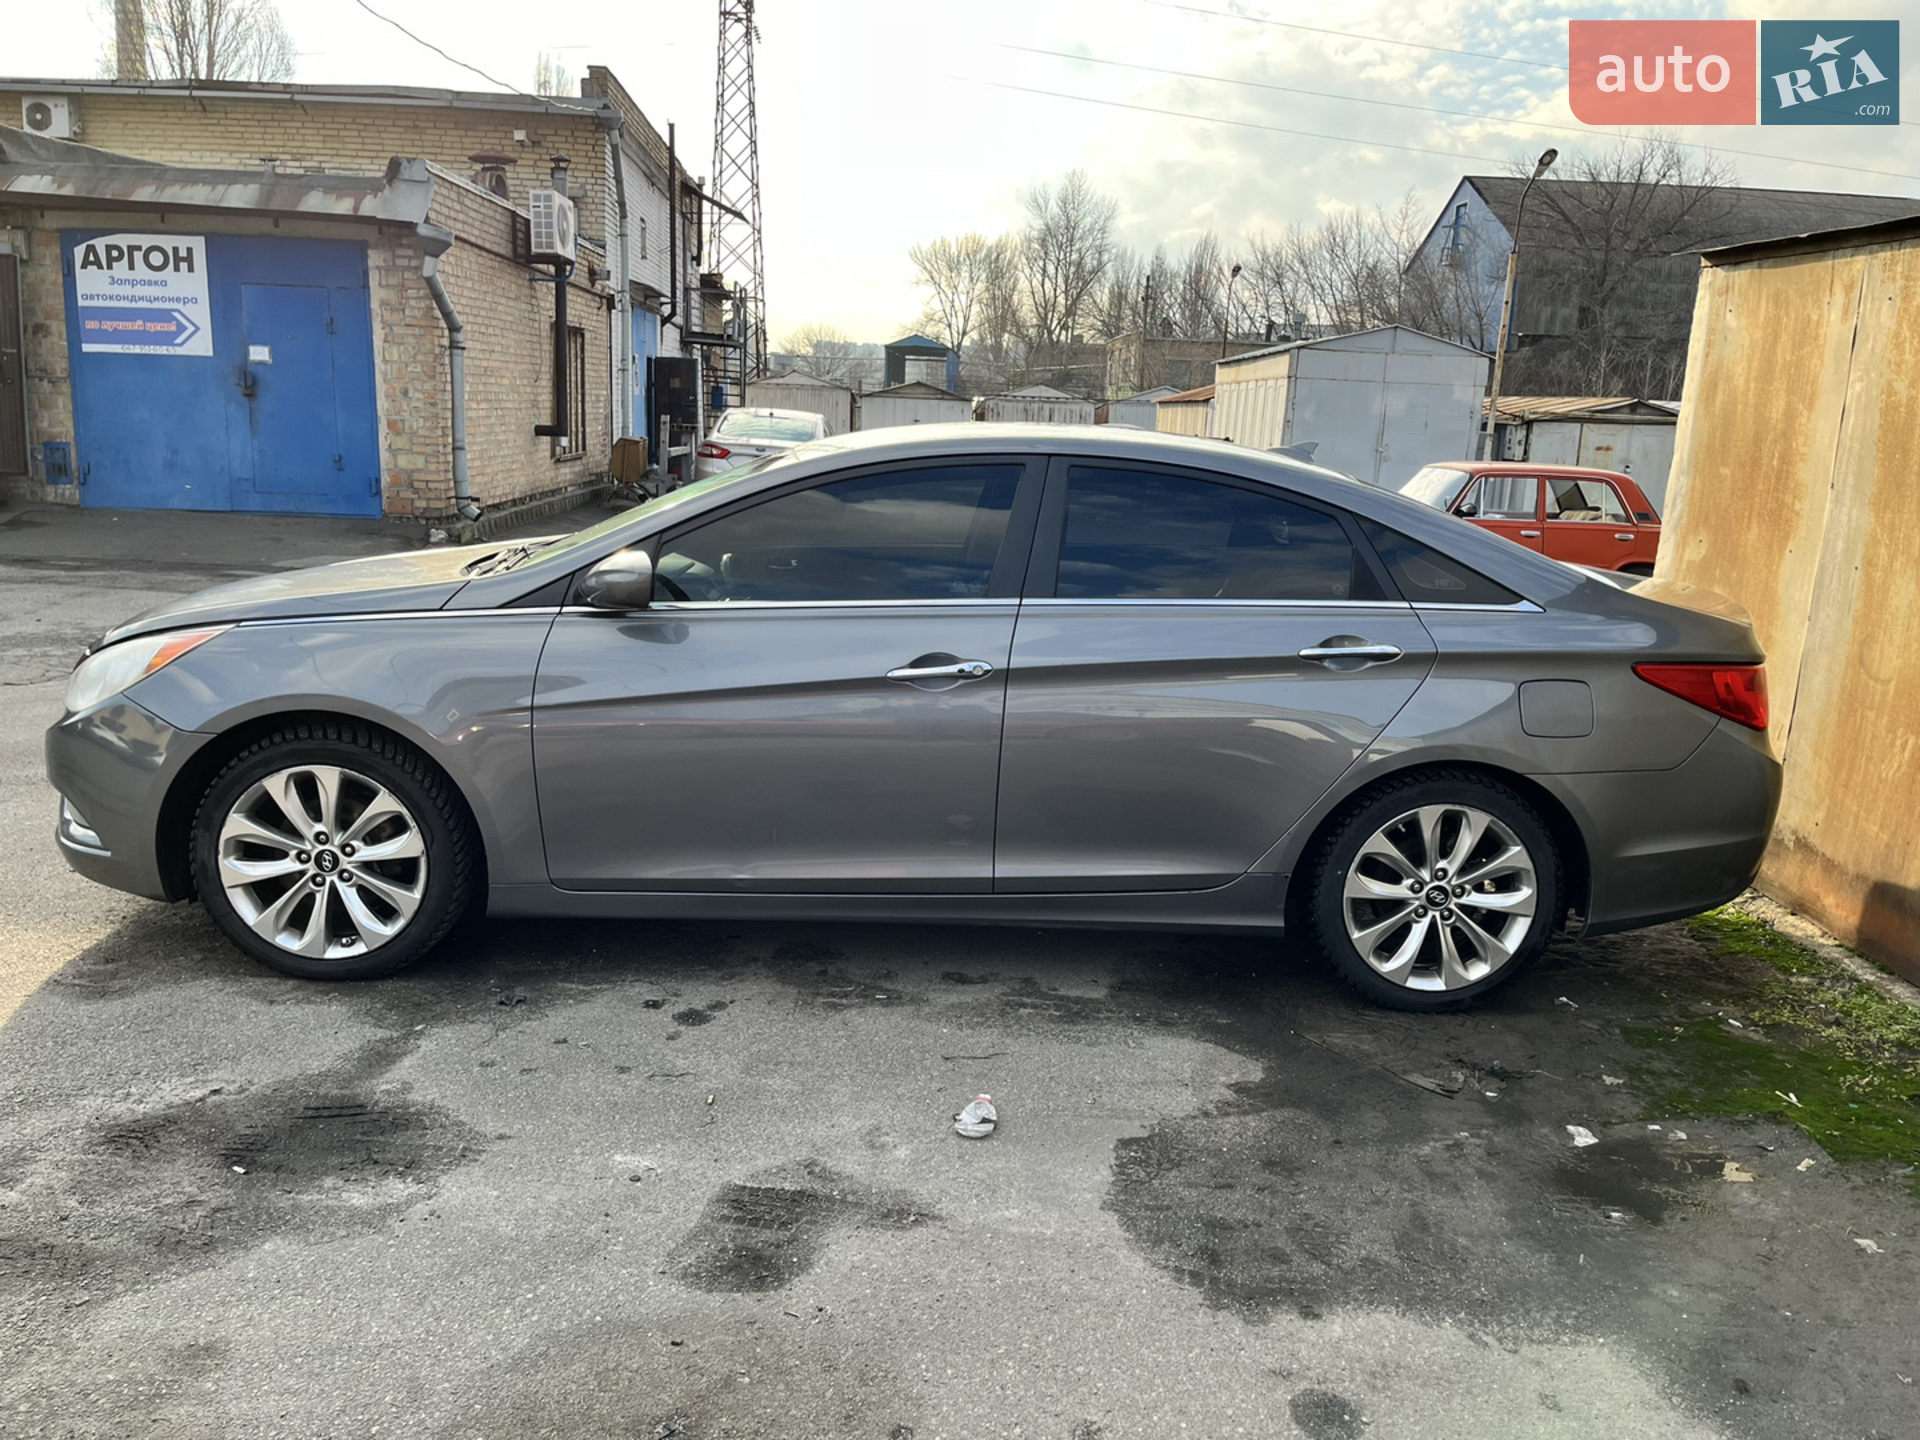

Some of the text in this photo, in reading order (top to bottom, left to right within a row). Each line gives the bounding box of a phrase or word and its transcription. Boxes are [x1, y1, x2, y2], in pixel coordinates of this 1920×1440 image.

[80, 243, 195, 273] АРГОН
[108, 275, 168, 288] Заправка
[80, 293, 199, 306] автокондиционера
